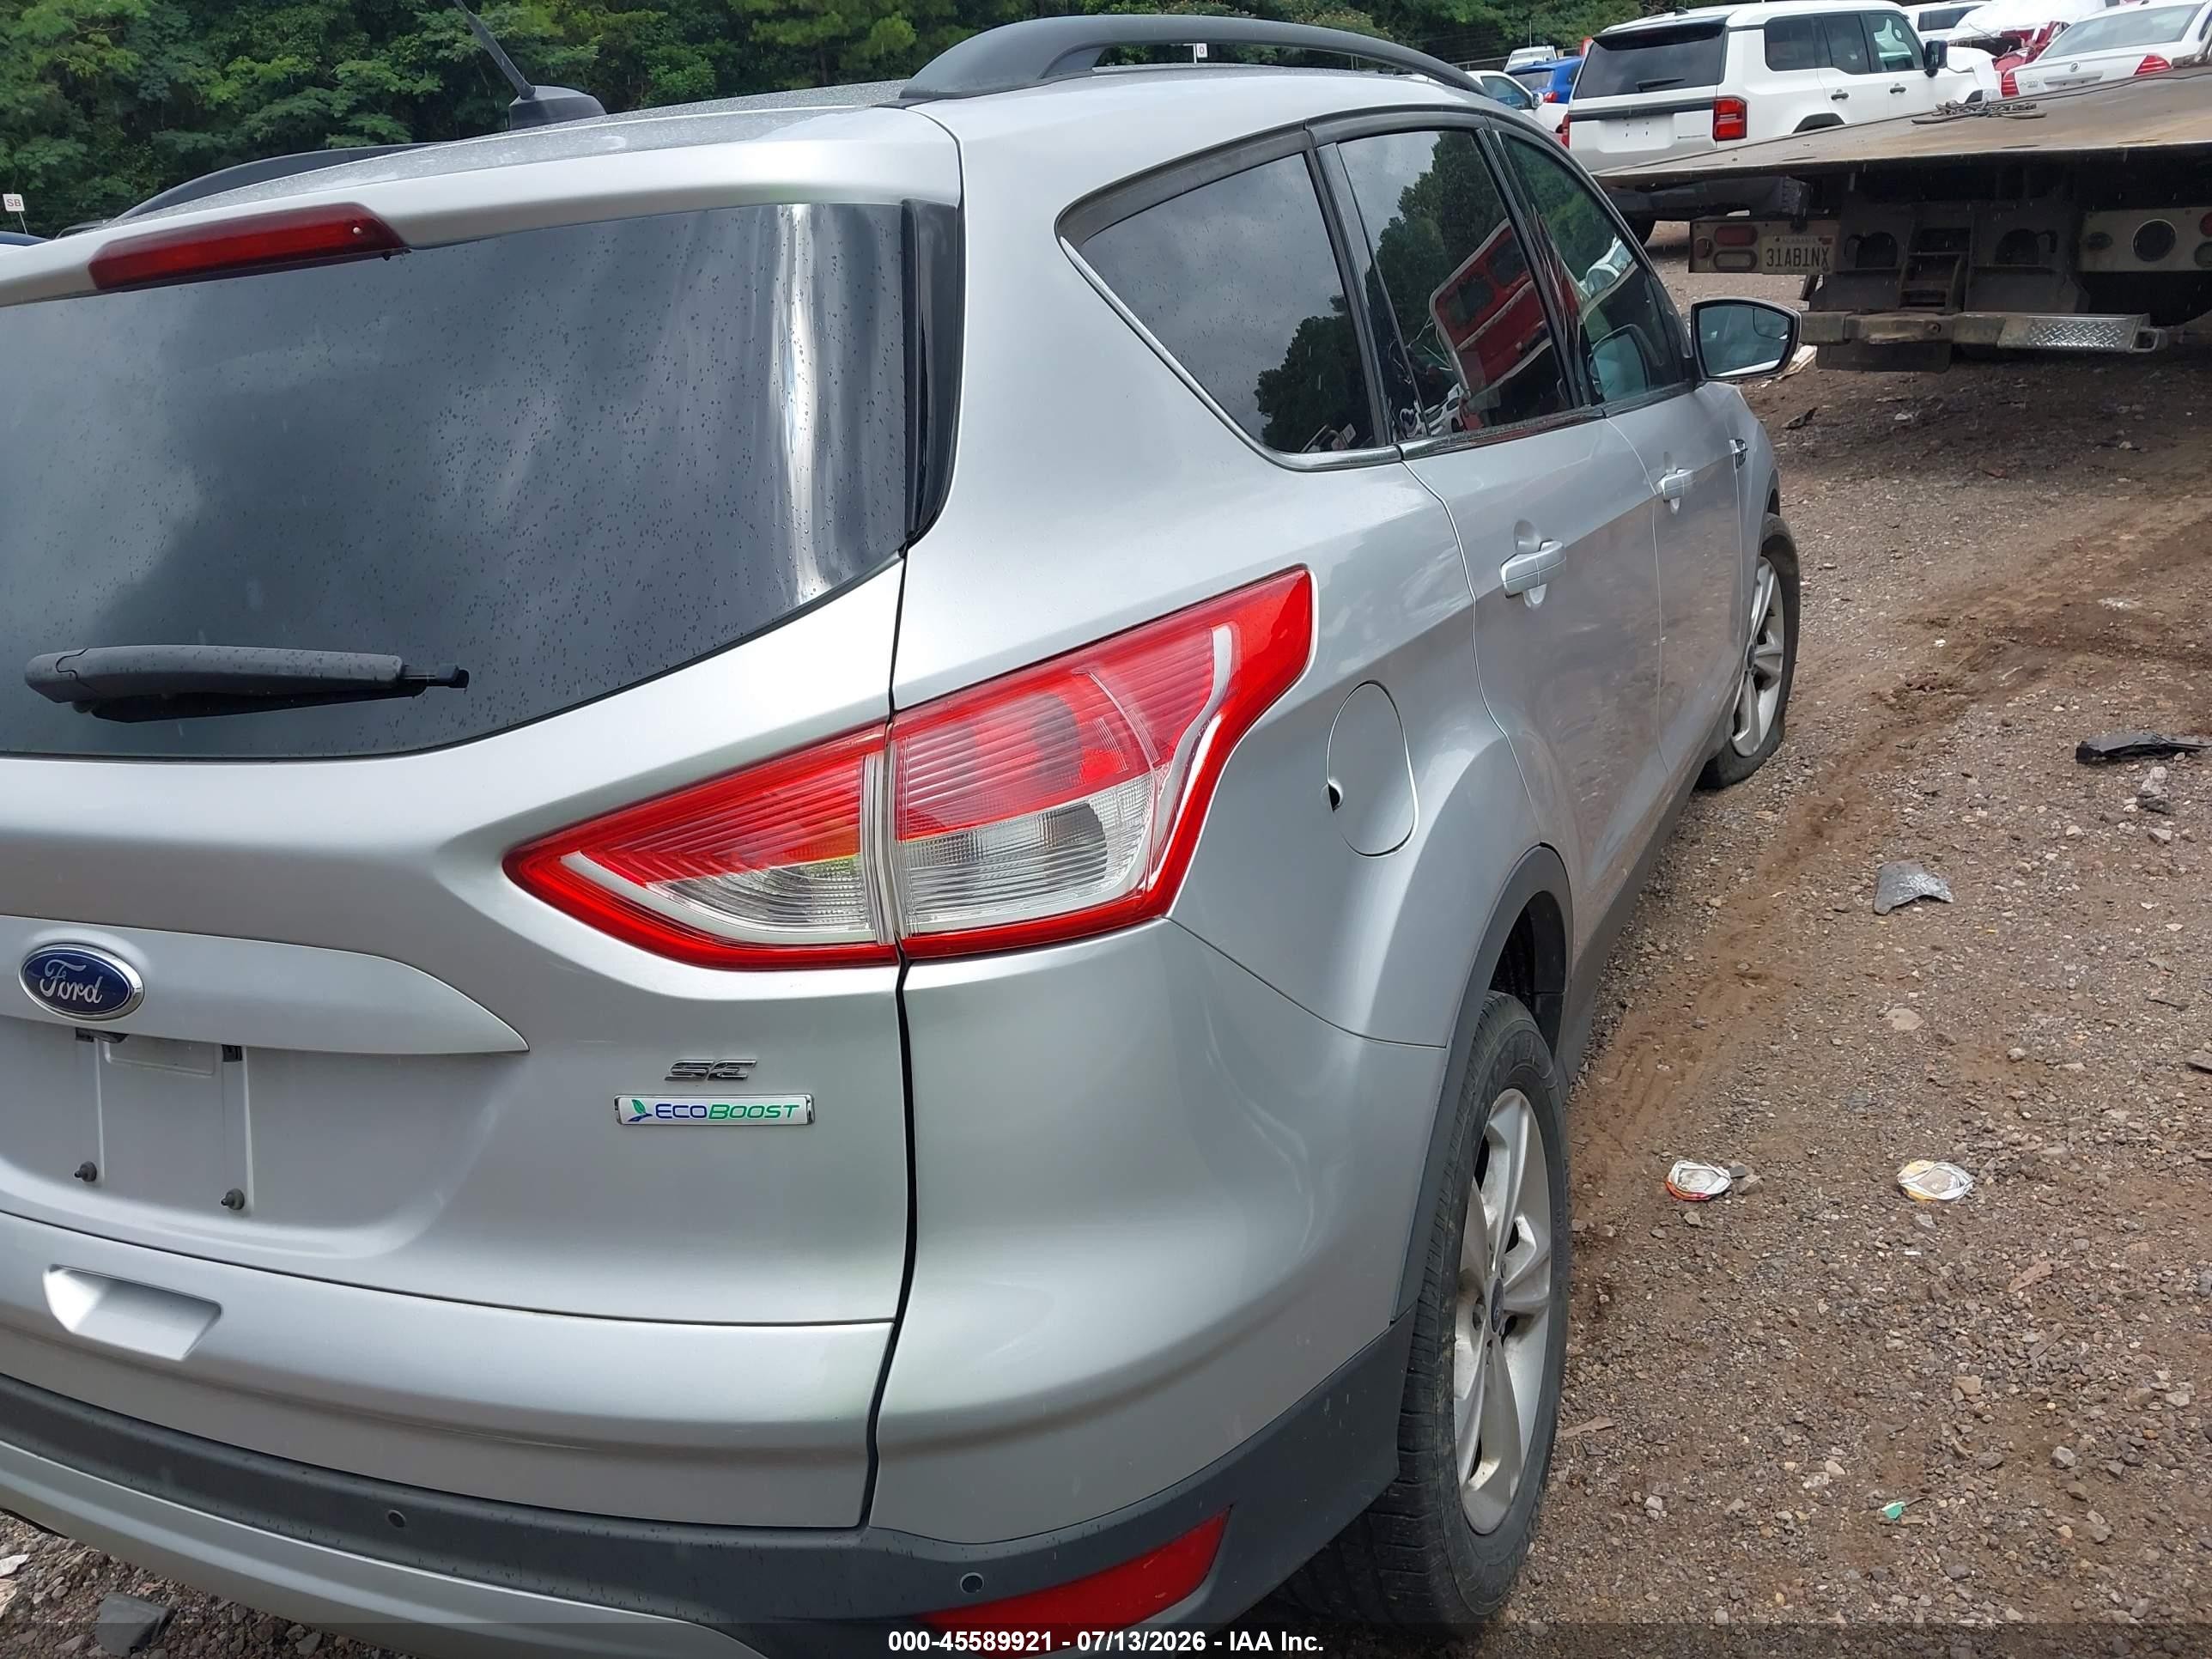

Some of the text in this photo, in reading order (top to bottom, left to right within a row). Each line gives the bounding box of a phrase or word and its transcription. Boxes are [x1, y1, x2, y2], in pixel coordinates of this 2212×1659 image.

[6, 198, 21, 207] SB
[40, 959, 103, 1004] Ford
[664, 1059, 757, 1081] SE
